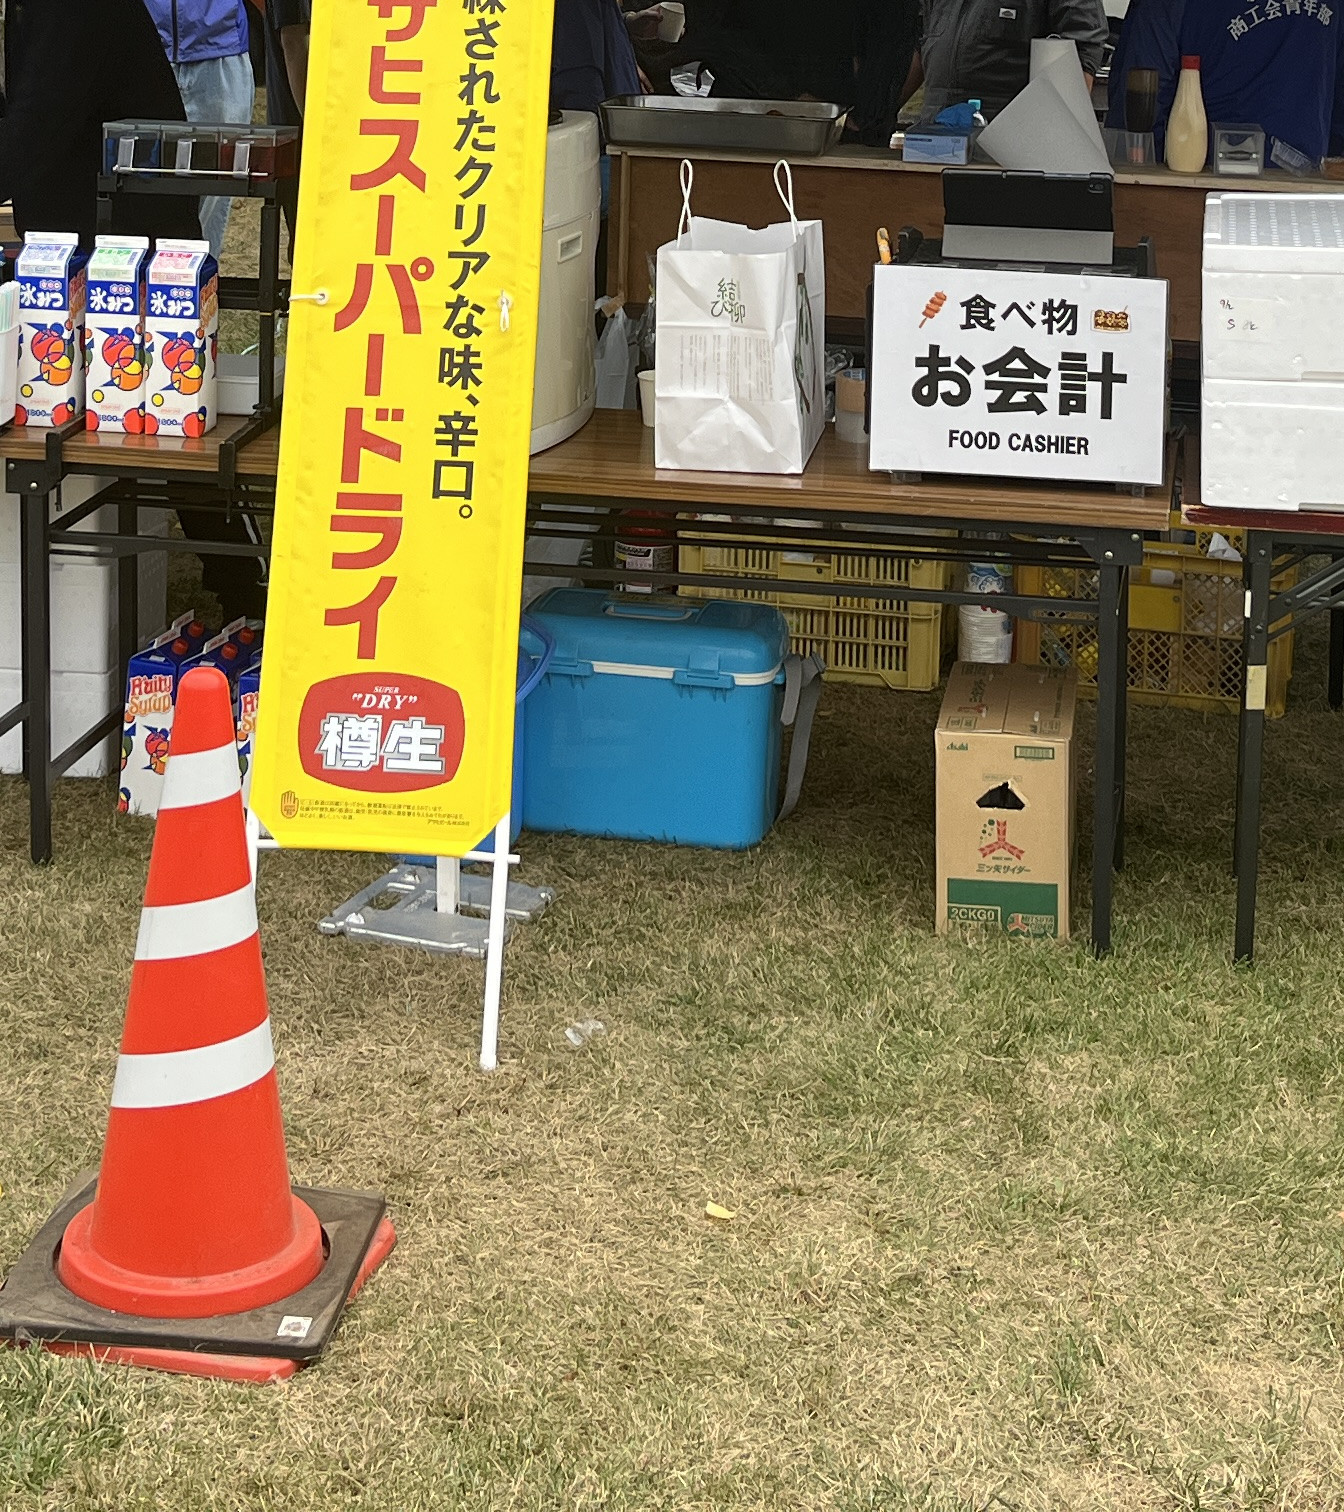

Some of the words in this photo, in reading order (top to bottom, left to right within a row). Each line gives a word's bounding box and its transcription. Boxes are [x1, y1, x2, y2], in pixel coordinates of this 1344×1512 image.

[20, 282, 64, 309] 氷みつ
[90, 287, 134, 313] 氷みつ
[150, 291, 195, 316] 氷みつ
[959, 294, 1079, 336] 食べ物
[911, 343, 1127, 420] お会計
[948, 430, 1000, 451] FOOD
[1007, 432, 1089, 455] CASHIER
[129, 695, 173, 717] Syrup
[315, 713, 445, 774] 樽生
[976, 863, 1031, 874] 三ツ矢サイダー
